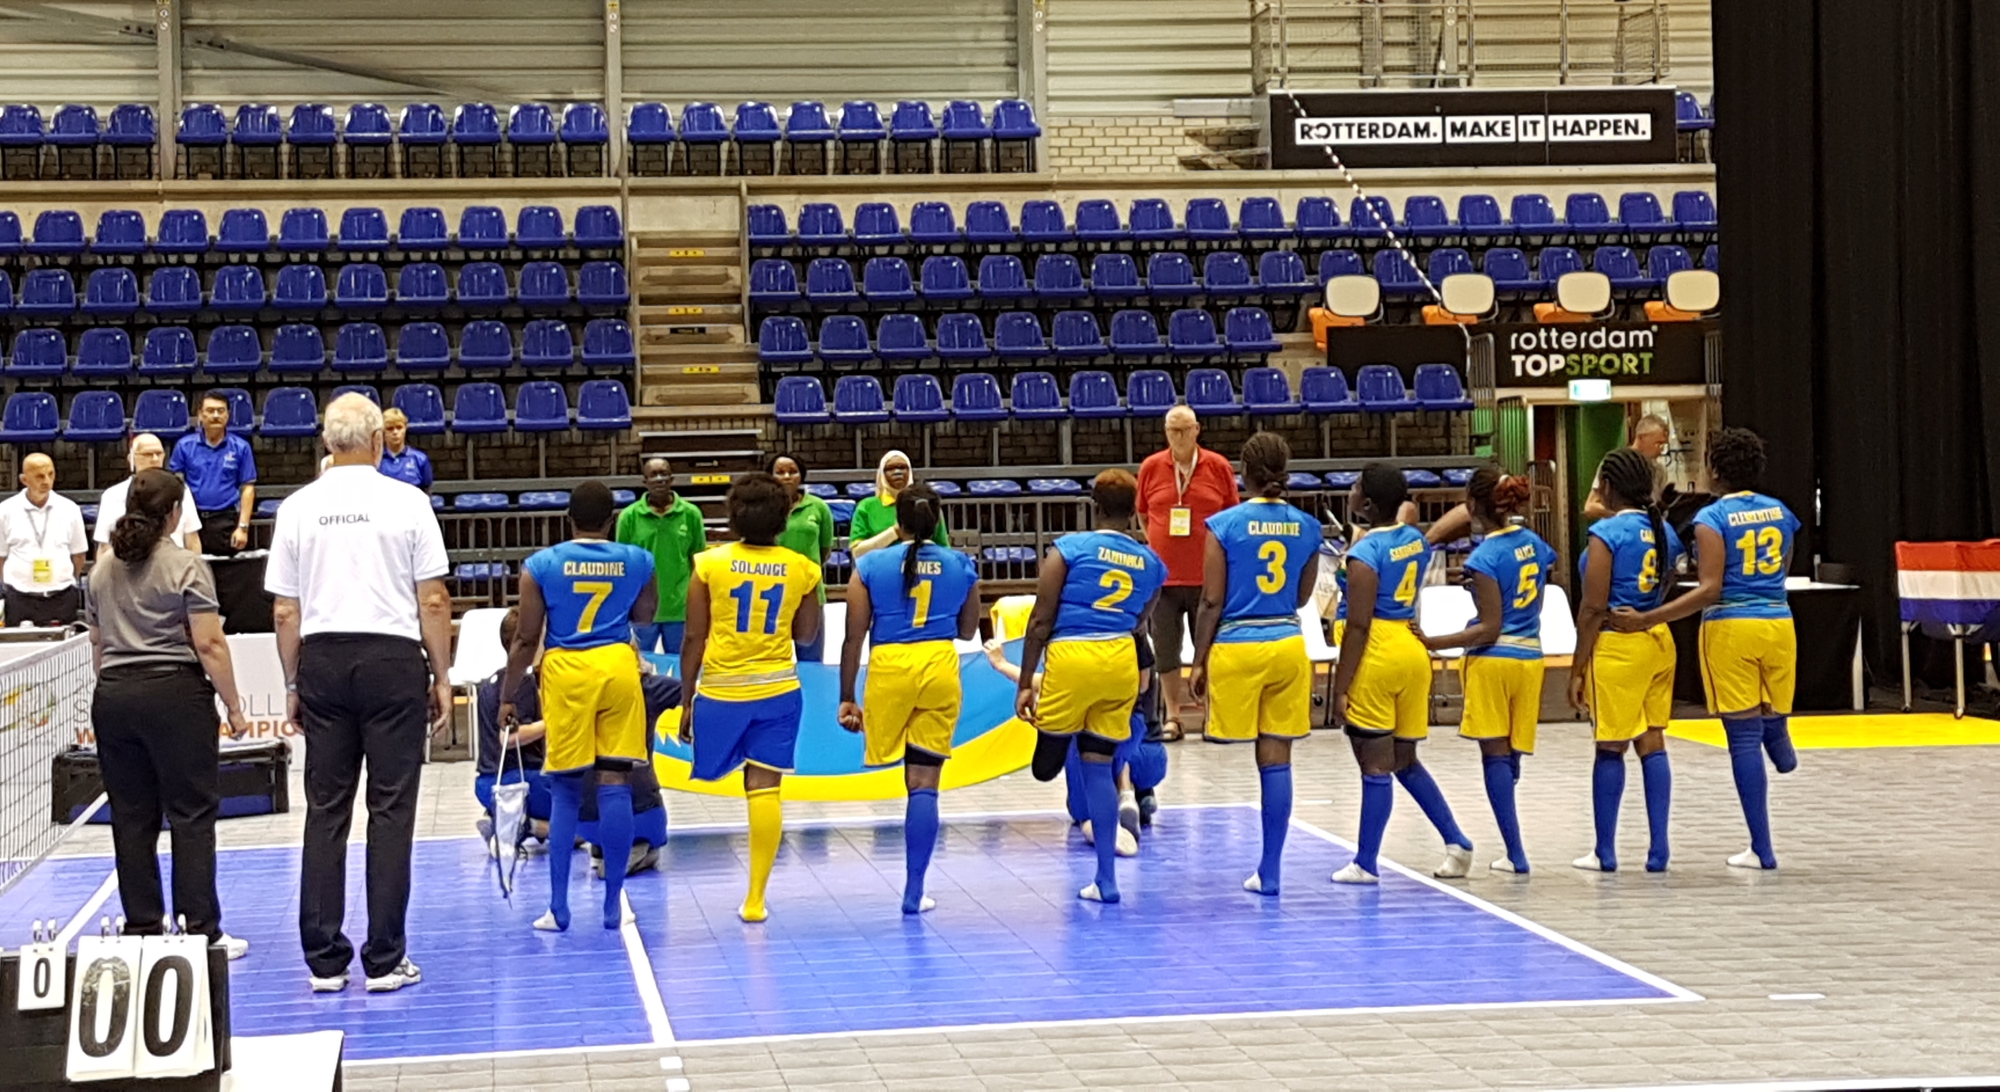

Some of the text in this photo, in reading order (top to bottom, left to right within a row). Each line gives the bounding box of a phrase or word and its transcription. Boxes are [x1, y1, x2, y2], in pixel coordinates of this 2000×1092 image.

[1300, 119, 1647, 140] ROTTERDAM. MAKE IT HAPPEN.
[1511, 326, 1654, 350] rotterdam
[1511, 352, 1654, 377] TOPSPORT
[319, 513, 371, 526] OFFICIAL
[1248, 520, 1301, 536] CLAUDINE
[564, 560, 625, 576] CLAUDINE
[731, 559, 787, 577] SOLANGE
[1256, 540, 1287, 594] 3
[1638, 547, 1660, 593] 8
[1736, 526, 1783, 575] 13
[910, 580, 932, 628] 1
[1092, 569, 1133, 612] 2
[1394, 560, 1417, 607] 4
[1513, 562, 1539, 608] 5
[573, 581, 613, 633] 7
[730, 580, 784, 634] 11
[34, 957, 50, 998] 0
